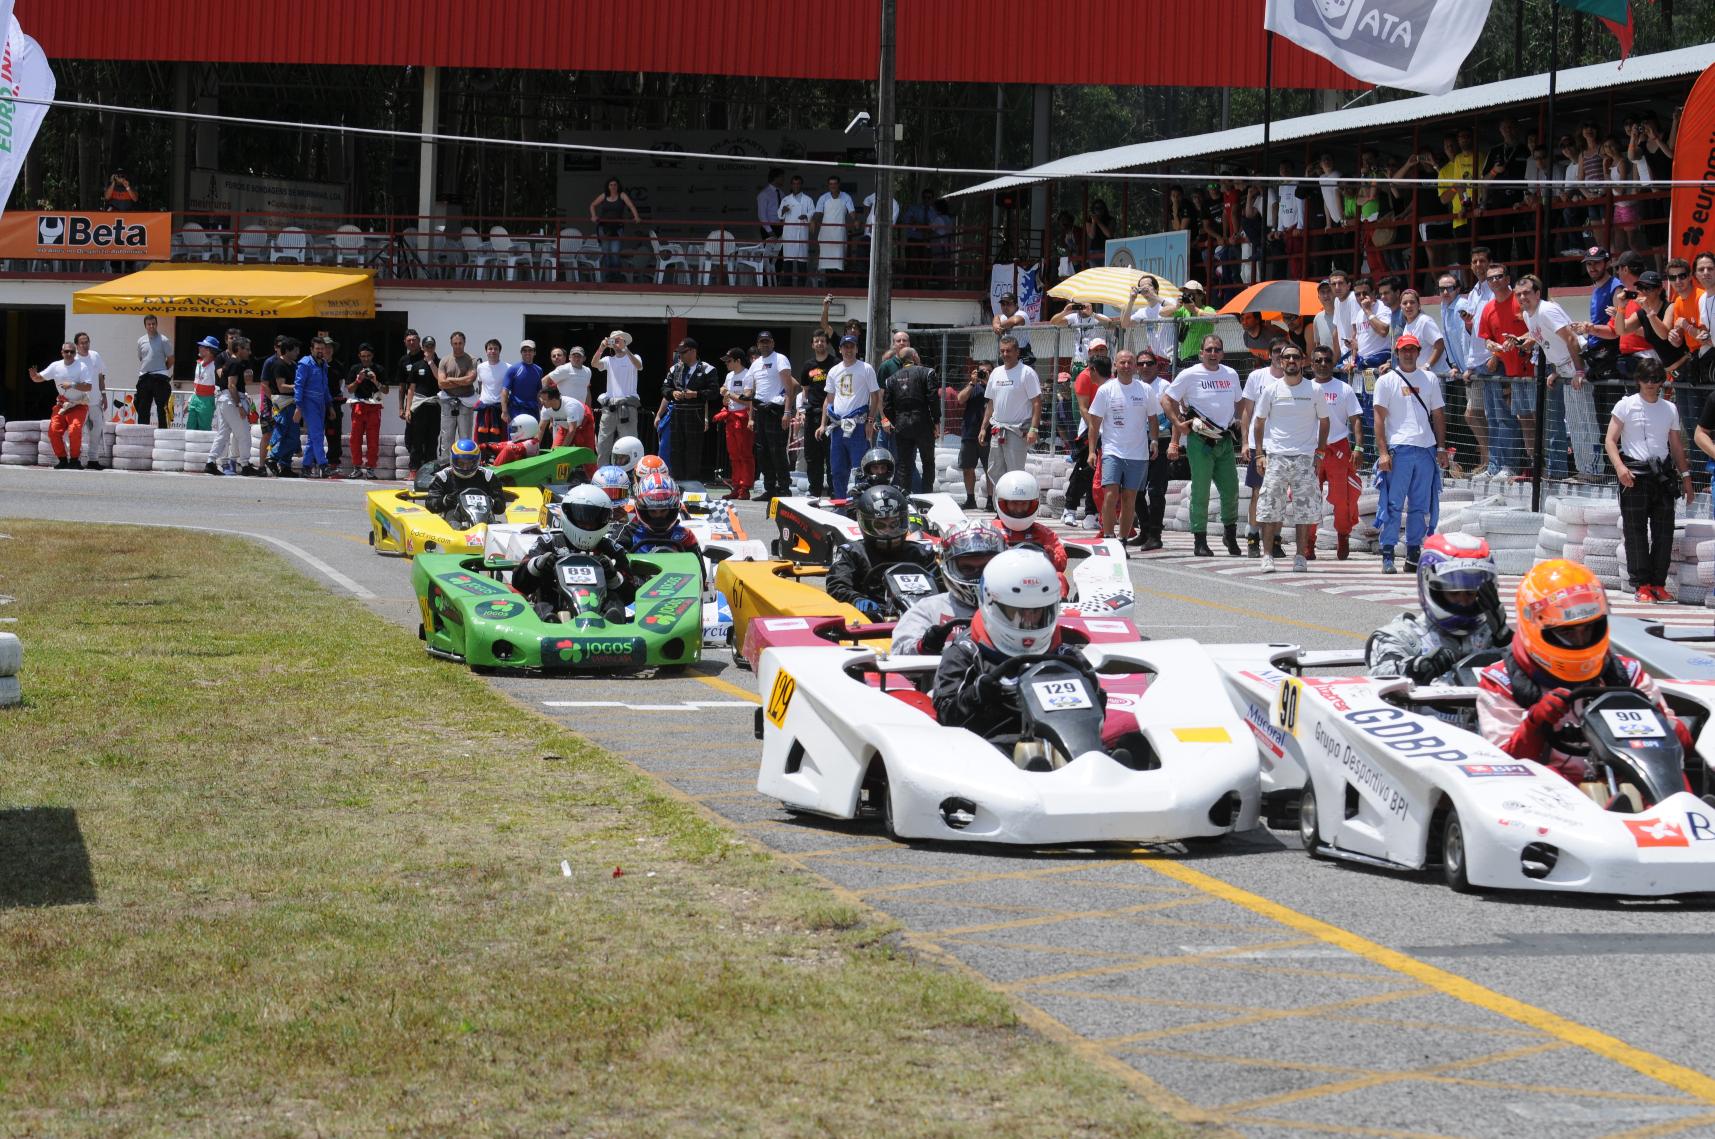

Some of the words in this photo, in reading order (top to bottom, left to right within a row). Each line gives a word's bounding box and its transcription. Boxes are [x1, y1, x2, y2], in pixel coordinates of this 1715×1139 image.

[1358, 8, 1413, 48] ATA
[68, 216, 148, 247] Beta
[113, 305, 279, 317] www.pestronix.pt
[1201, 379, 1232, 391] UNITRIP
[900, 574, 922, 584] 67
[1022, 577, 1041, 586] BELL
[586, 642, 633, 659] JOGOS
[767, 668, 796, 722] 129
[1043, 682, 1077, 696] 129
[1279, 680, 1298, 728] 90
[1247, 704, 1286, 747] Mucoral
[1615, 711, 1642, 722] 90
[1344, 708, 1468, 763] GDBP
[1314, 721, 1340, 759] Grupo
[1343, 745, 1390, 803] Desportivo
[1389, 791, 1409, 821] BPI
